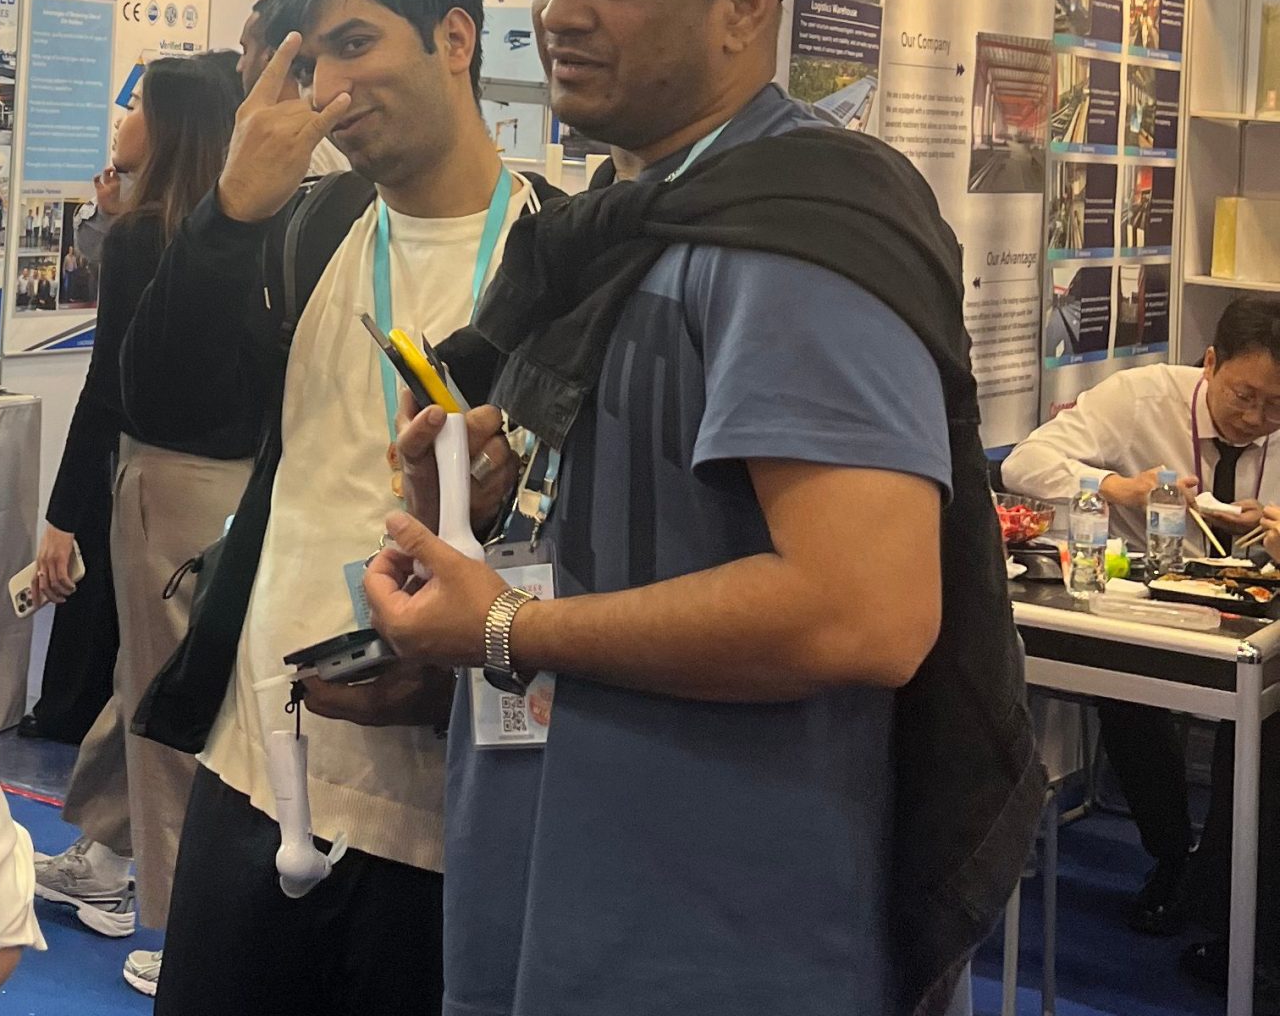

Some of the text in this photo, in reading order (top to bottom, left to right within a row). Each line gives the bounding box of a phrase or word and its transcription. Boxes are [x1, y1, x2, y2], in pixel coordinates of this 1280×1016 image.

[901, 32, 916, 48] Our
[917, 33, 951, 56] Company
[987, 251, 999, 266] Our
